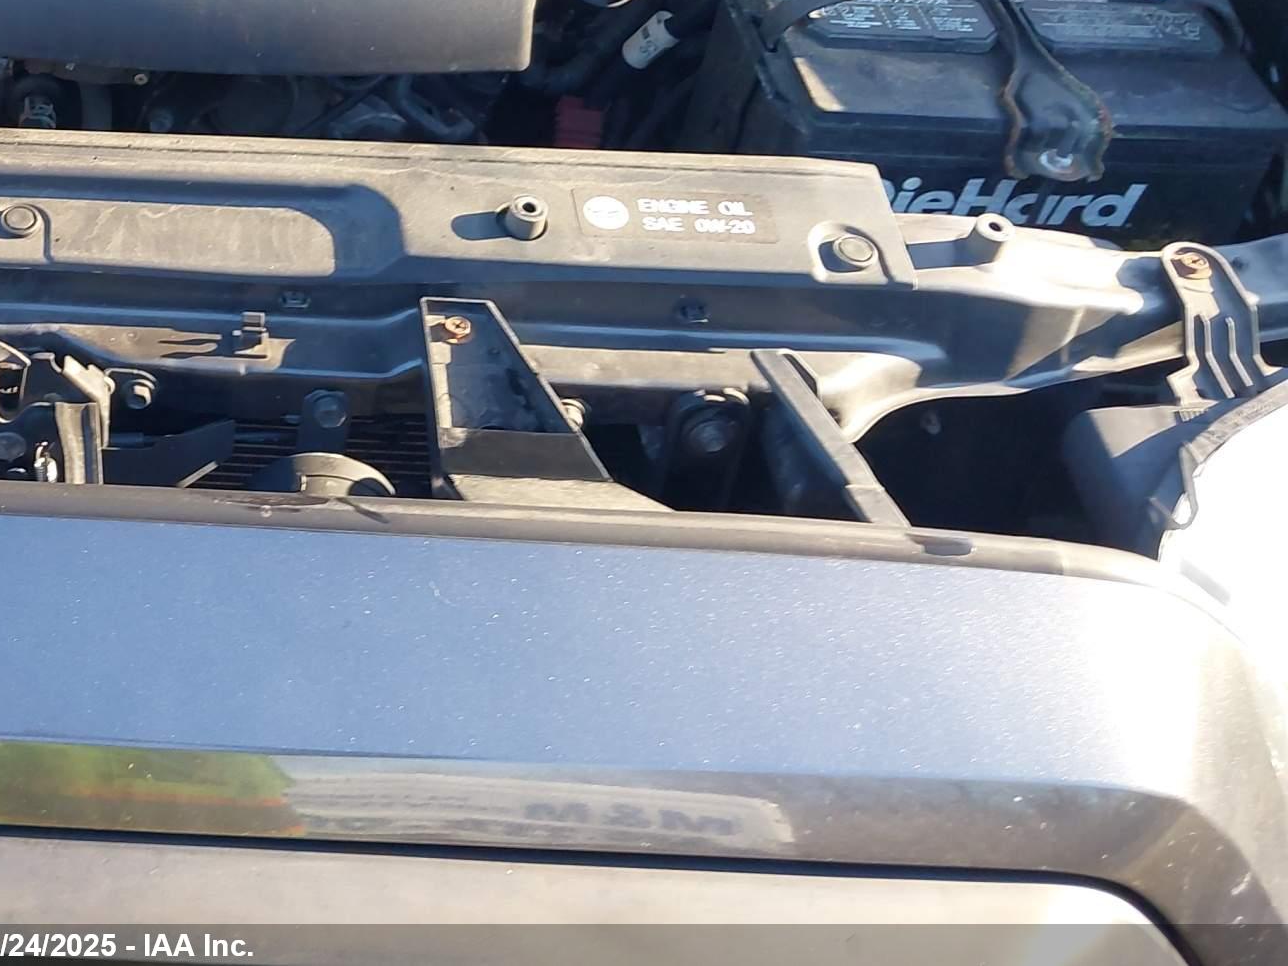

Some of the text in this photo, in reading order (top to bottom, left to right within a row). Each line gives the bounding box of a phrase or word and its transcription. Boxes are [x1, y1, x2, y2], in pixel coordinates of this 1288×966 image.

[636, 198, 754, 216] ENGINE OIL
[641, 216, 757, 235] SAE 0W-20
